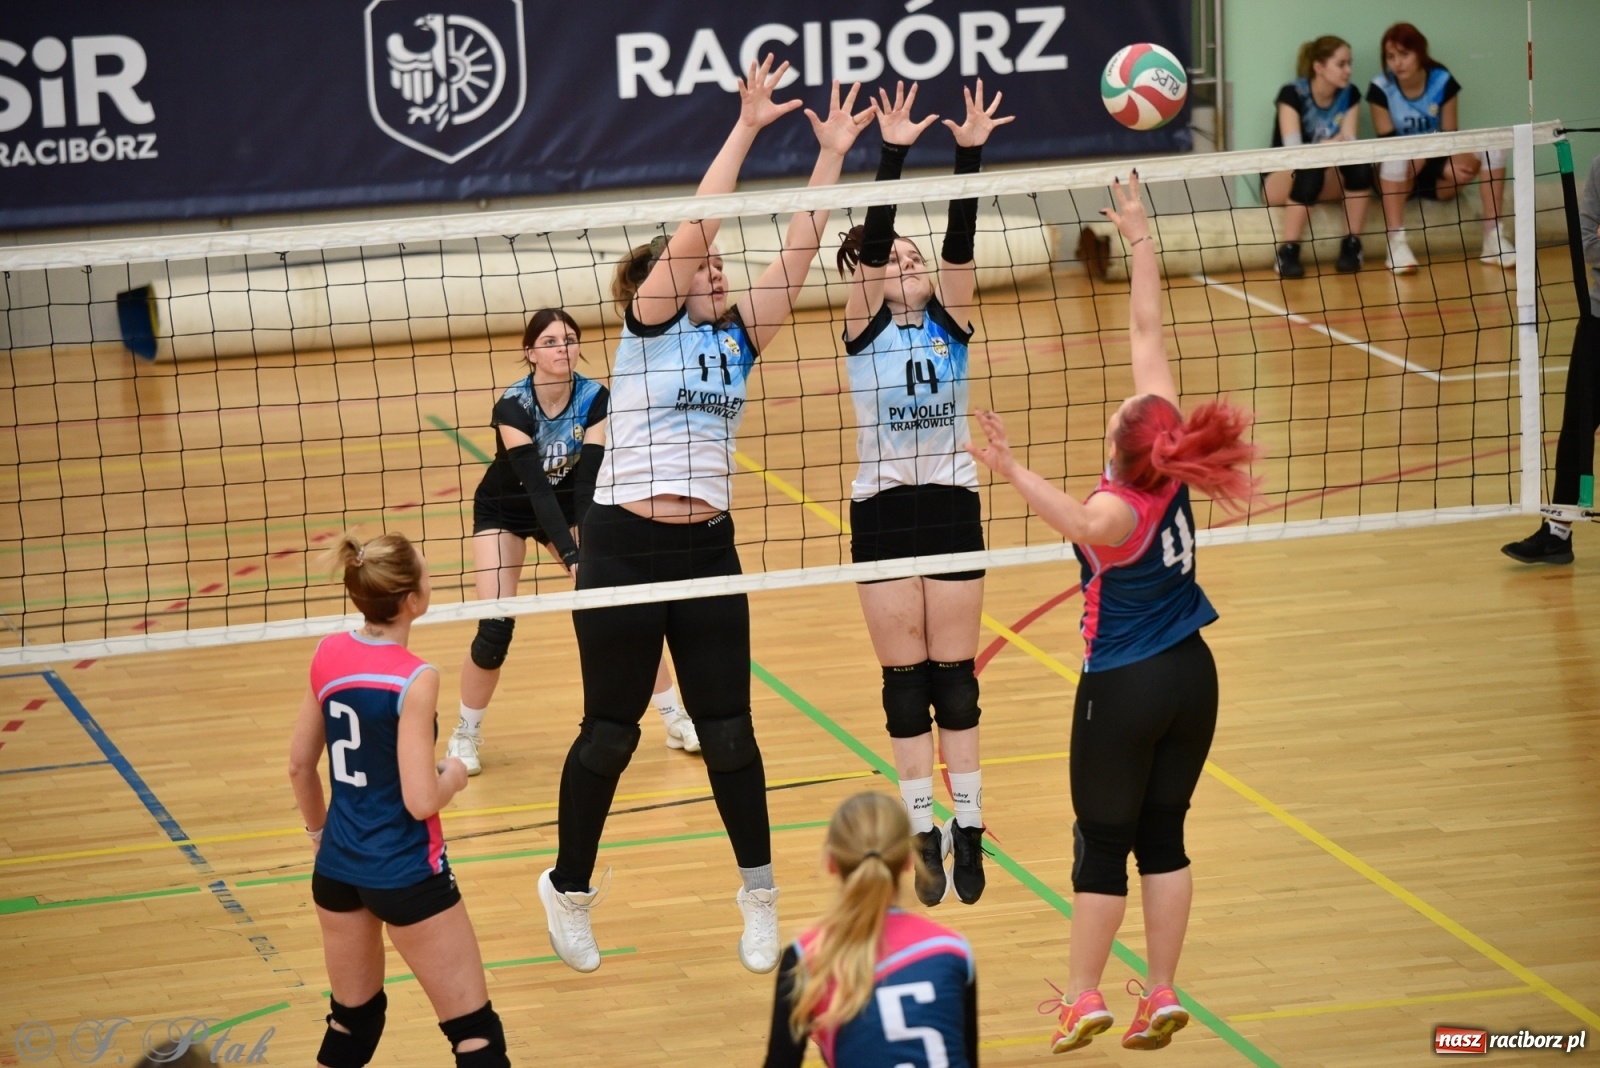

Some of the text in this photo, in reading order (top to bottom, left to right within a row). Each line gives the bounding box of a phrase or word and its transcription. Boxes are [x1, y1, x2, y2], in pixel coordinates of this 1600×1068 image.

[616, 0, 1068, 99] RACIBÓRZ
[677, 388, 746, 411] PV VOLLEY
[906, 358, 940, 396] 14
[888, 401, 956, 420] PV VOLLEY
[890, 416, 955, 432] KRAPKOWICE
[1160, 506, 1195, 575] 4
[329, 700, 368, 788] 2
[875, 980, 949, 1068] 5
